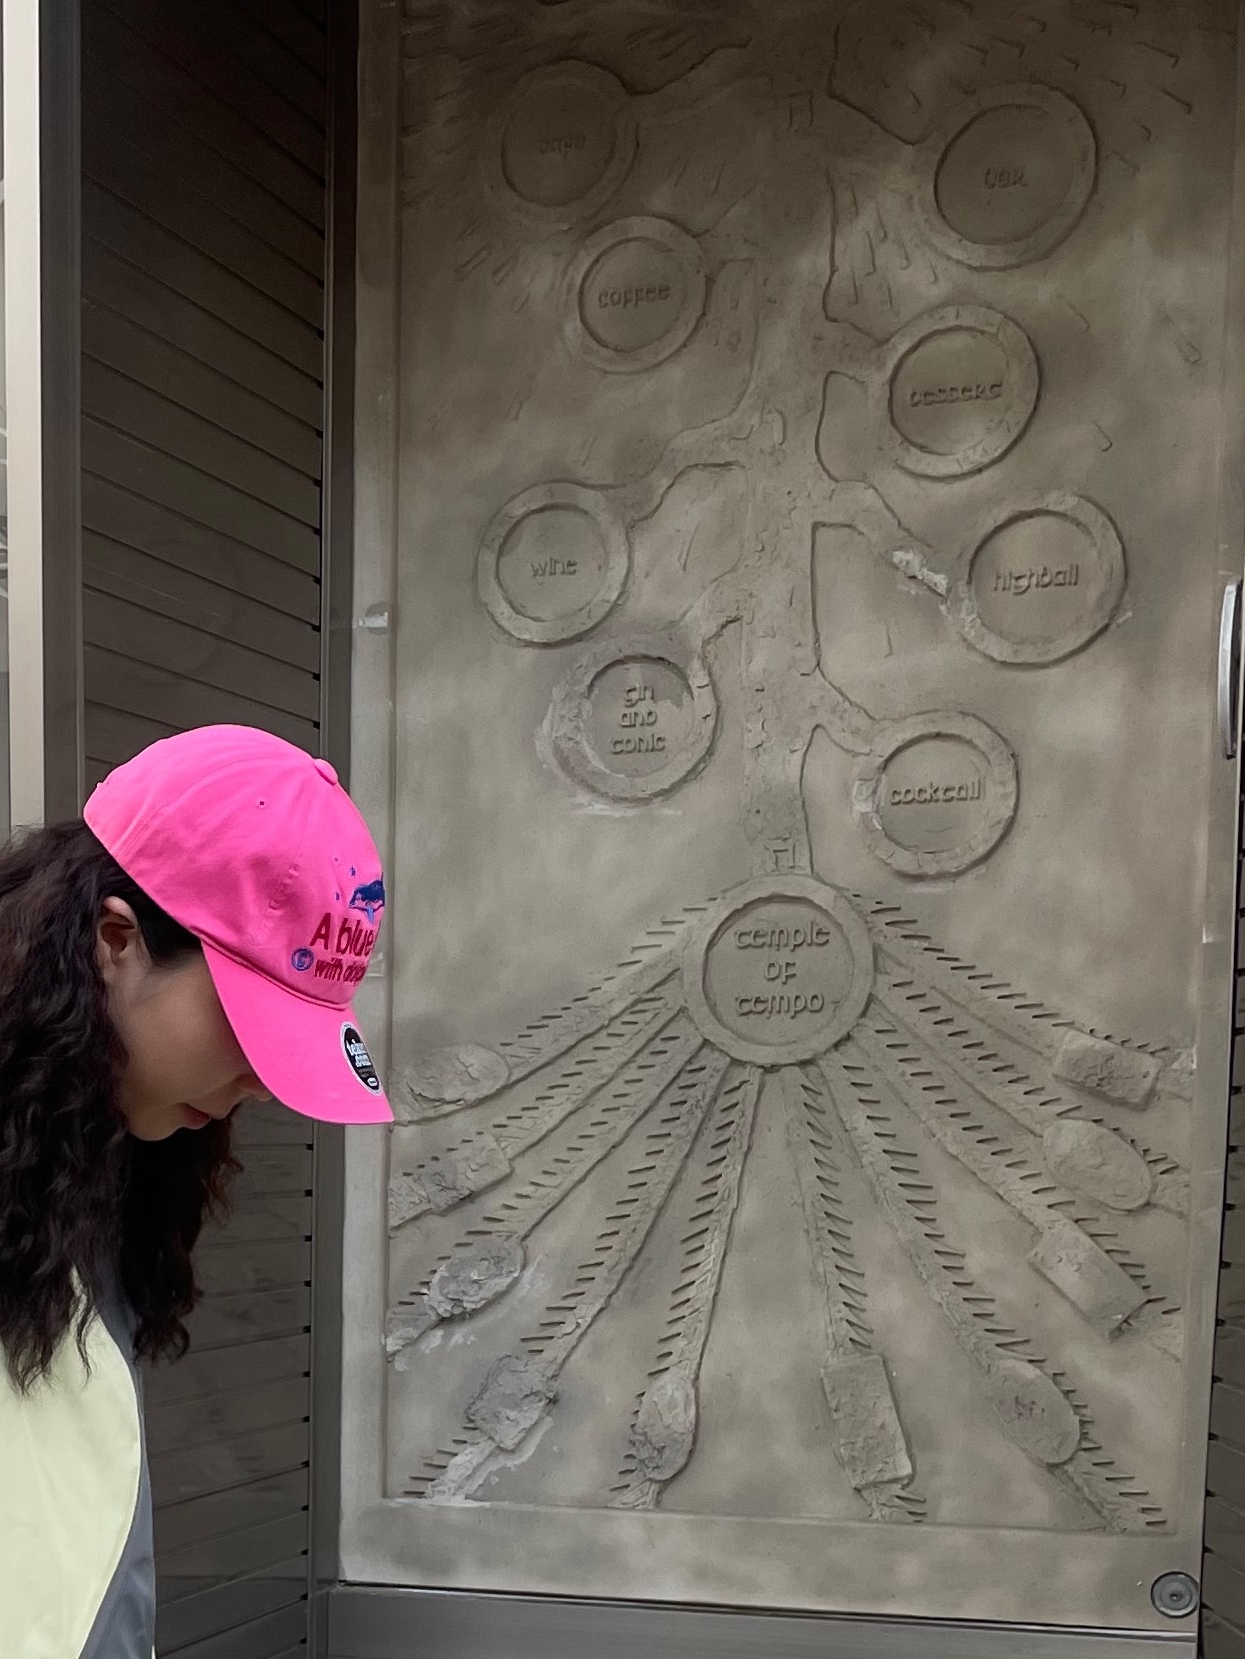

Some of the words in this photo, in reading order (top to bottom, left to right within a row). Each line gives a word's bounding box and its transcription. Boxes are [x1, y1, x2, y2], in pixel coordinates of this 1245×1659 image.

[530, 556, 578, 578] wine
[993, 563, 1079, 596] highball
[624, 684, 655, 709] gin
[620, 708, 658, 729] and
[610, 733, 666, 755] tonic
[889, 780, 982, 806] cocktail
[309, 912, 332, 951] A
[336, 917, 374, 957] blue
[734, 920, 831, 953] temple
[734, 992, 825, 1020] tempo
